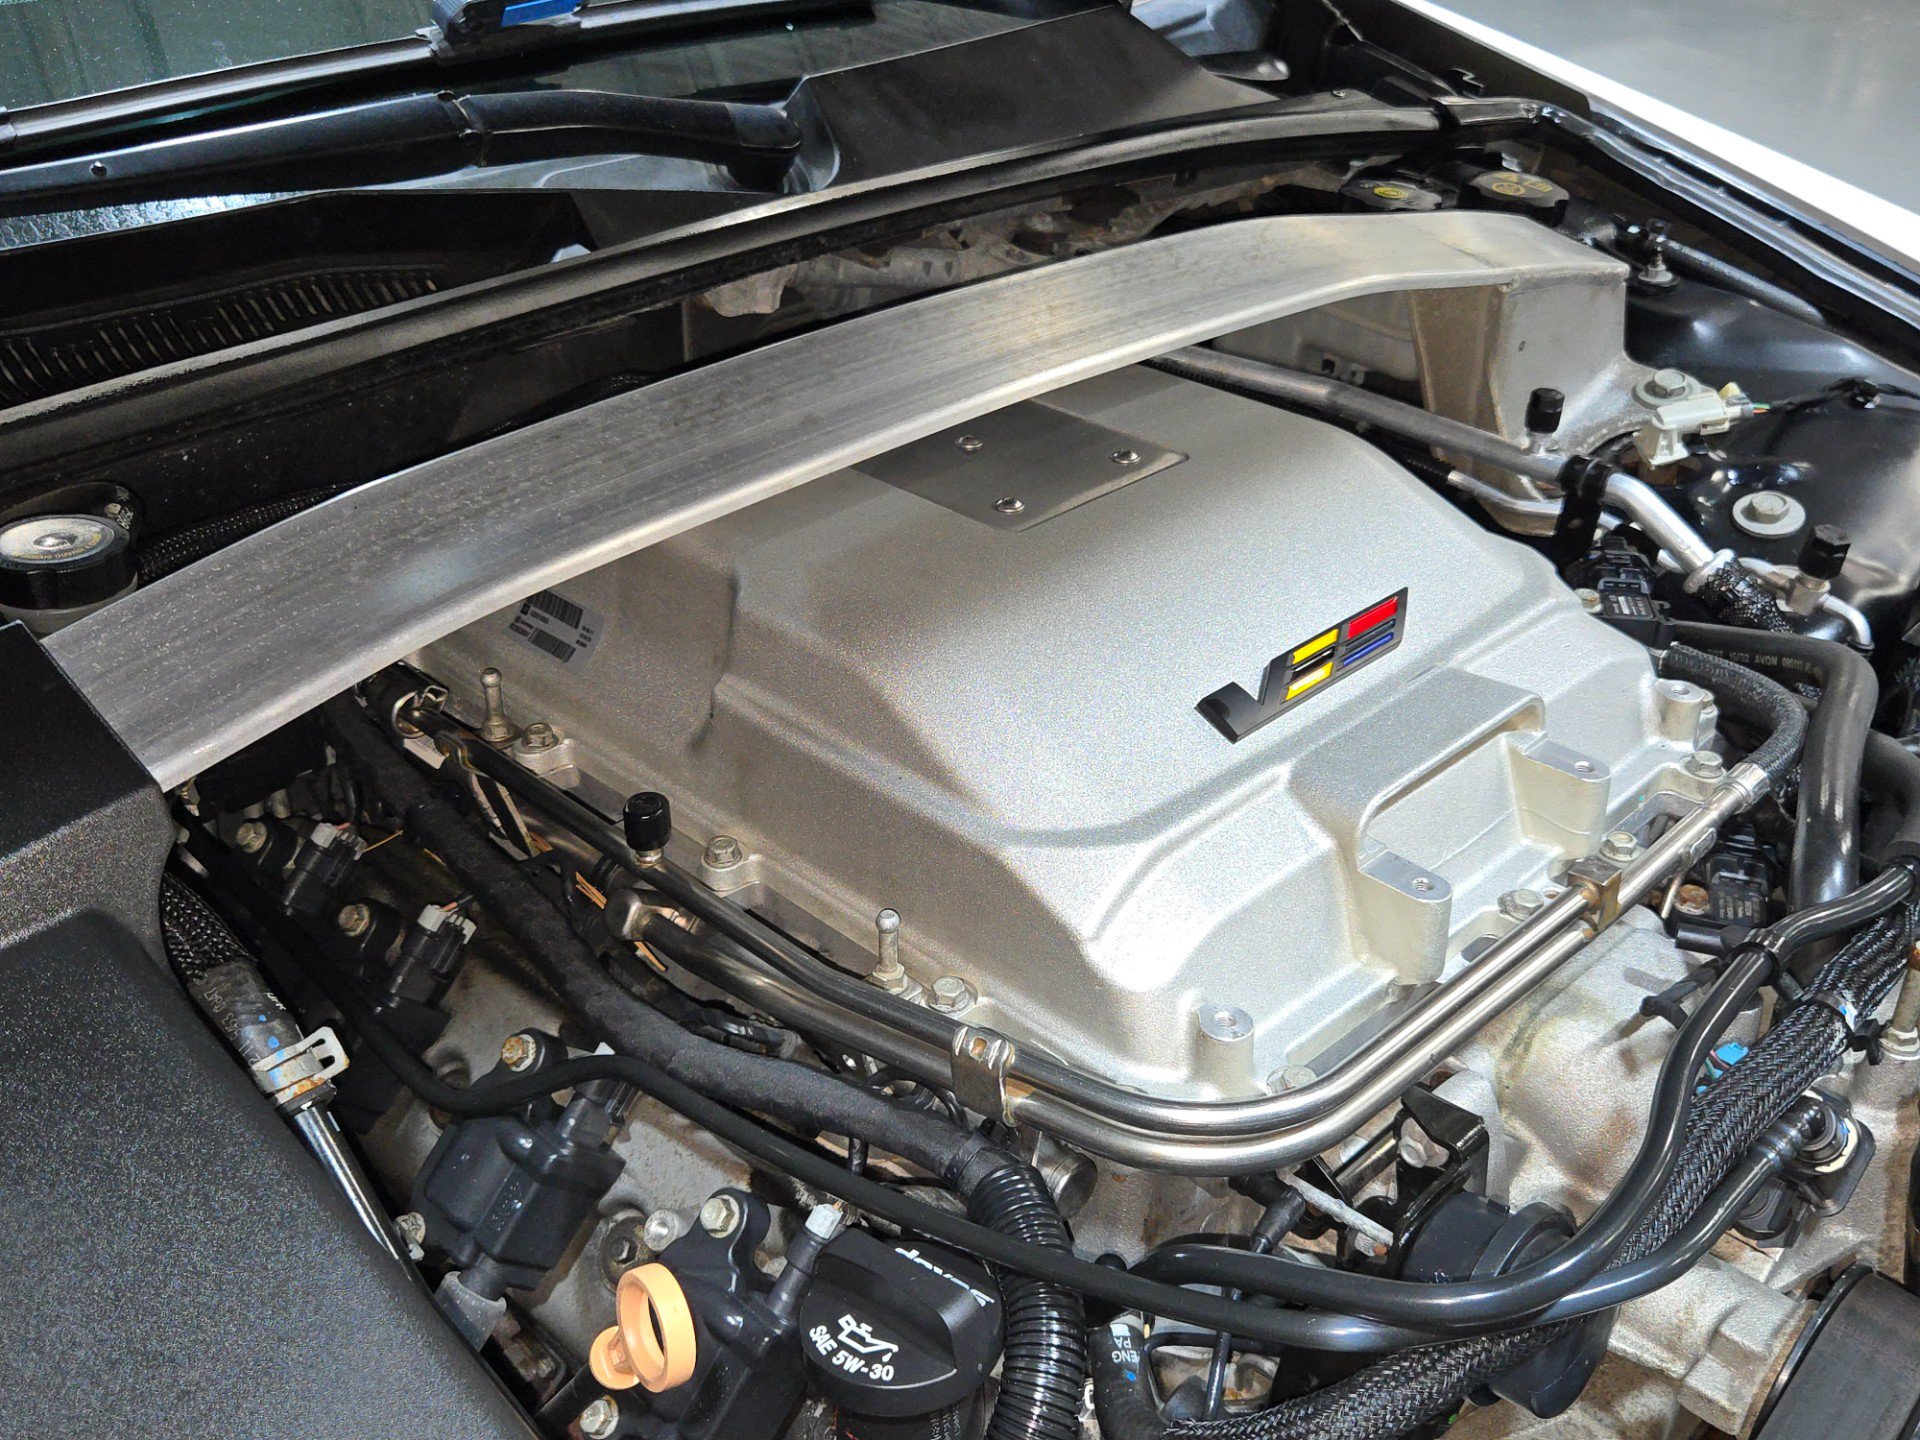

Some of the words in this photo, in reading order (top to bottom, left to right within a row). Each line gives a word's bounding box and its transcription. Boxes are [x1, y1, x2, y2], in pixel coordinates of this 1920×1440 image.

[1754, 654, 1778, 667] AVON
[809, 1325, 837, 1356] SAE
[832, 1350, 894, 1381] 5W-30
[1112, 1350, 1139, 1363] ENG
